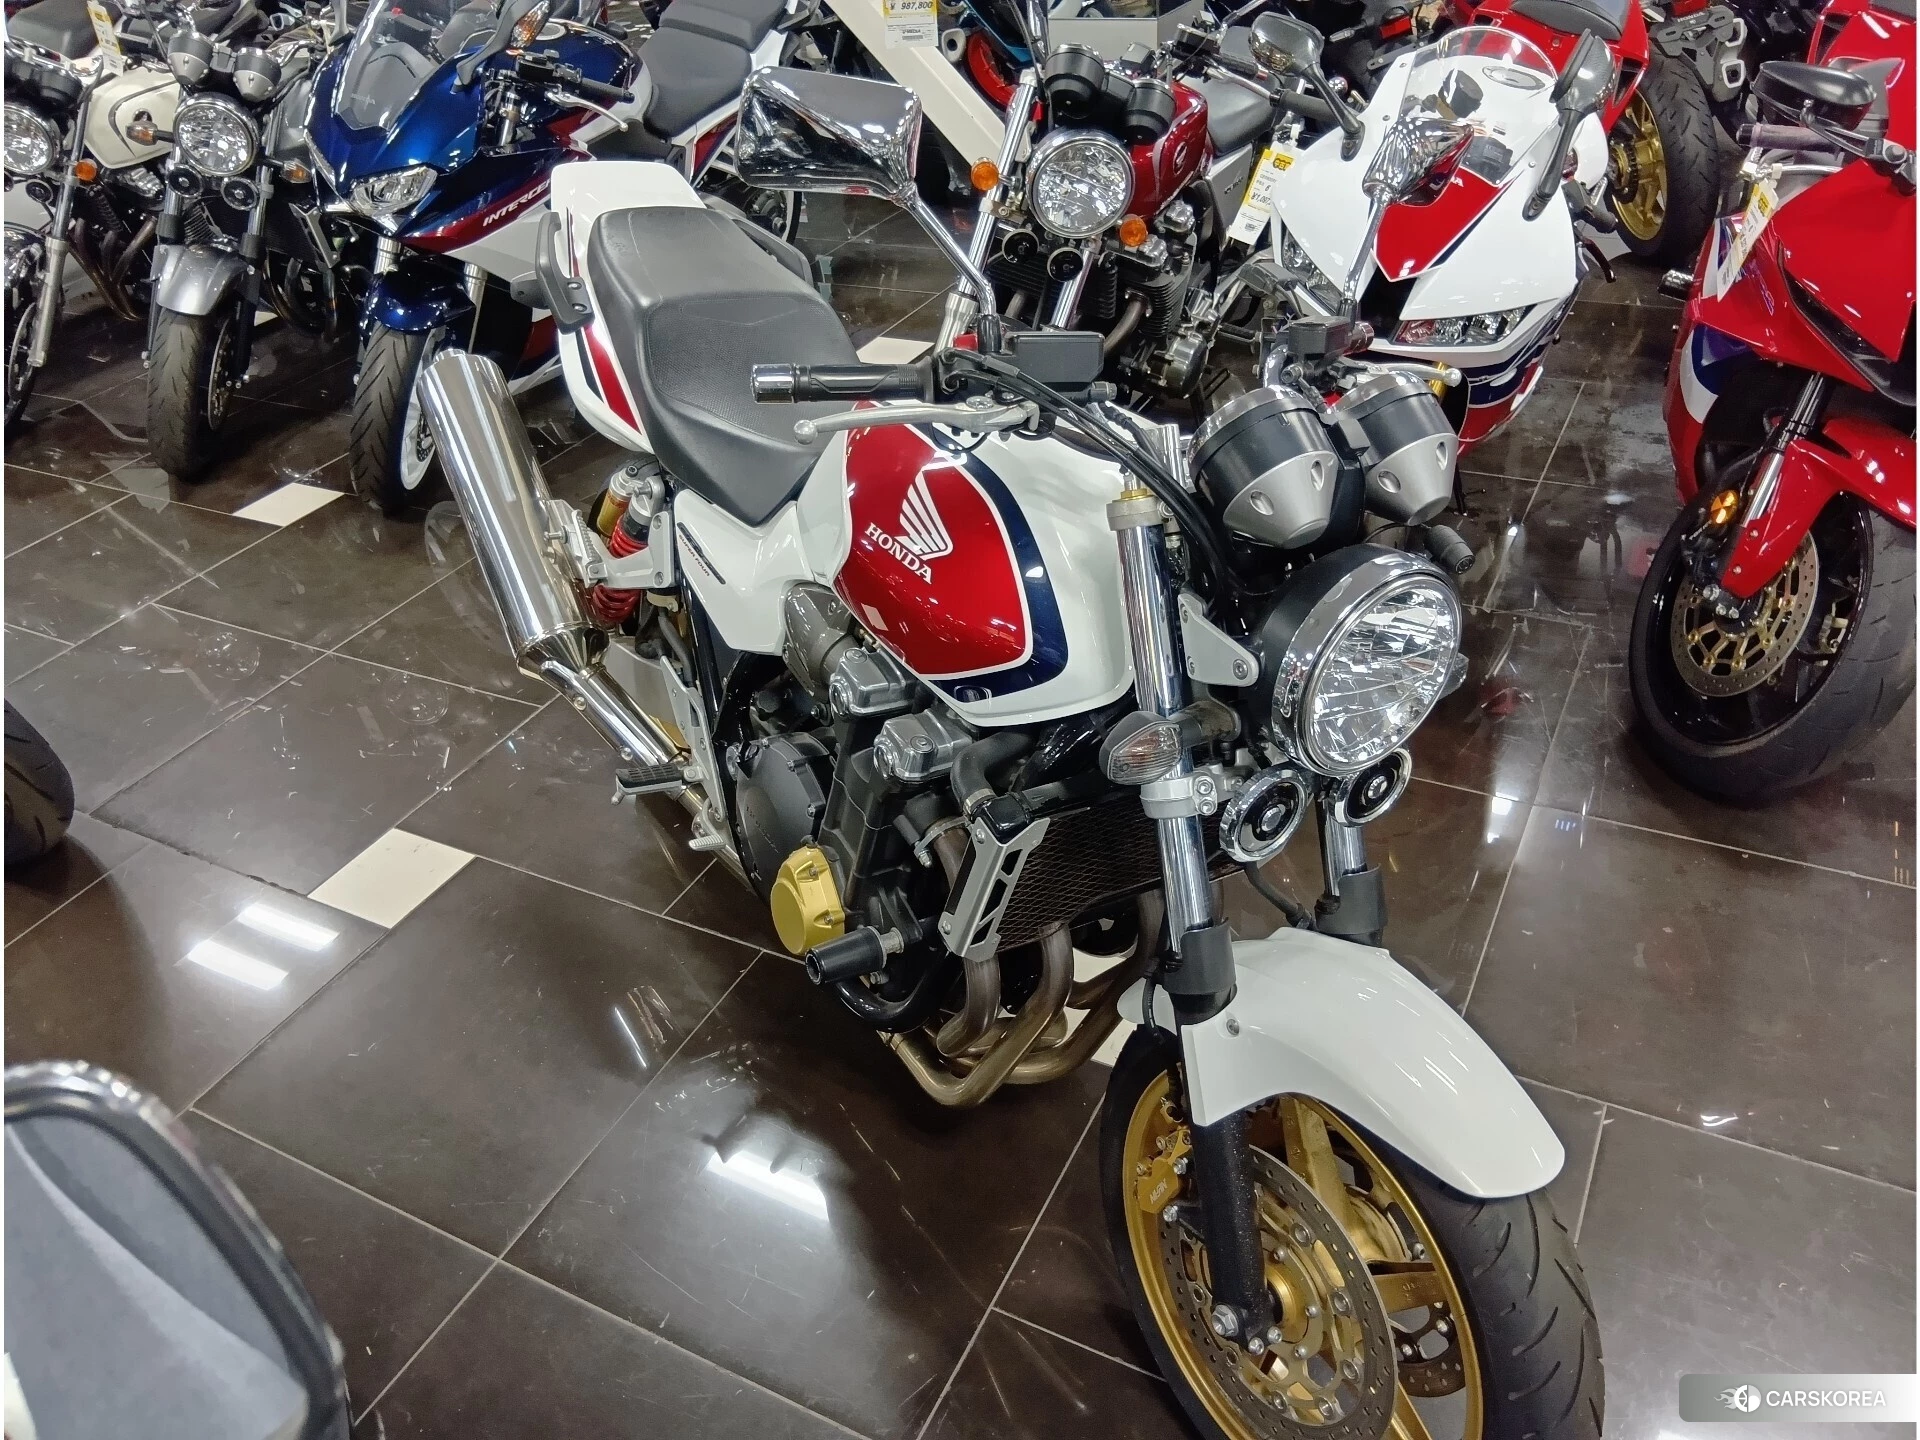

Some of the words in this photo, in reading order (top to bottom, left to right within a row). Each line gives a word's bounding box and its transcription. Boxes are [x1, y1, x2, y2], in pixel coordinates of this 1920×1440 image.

[901, 1, 933, 10] 987,800
[1677, 11, 1706, 22] HONDA
[679, 534, 696, 557] SUPER
[695, 557, 710, 576] FOUR
[864, 522, 932, 585] HONDA
